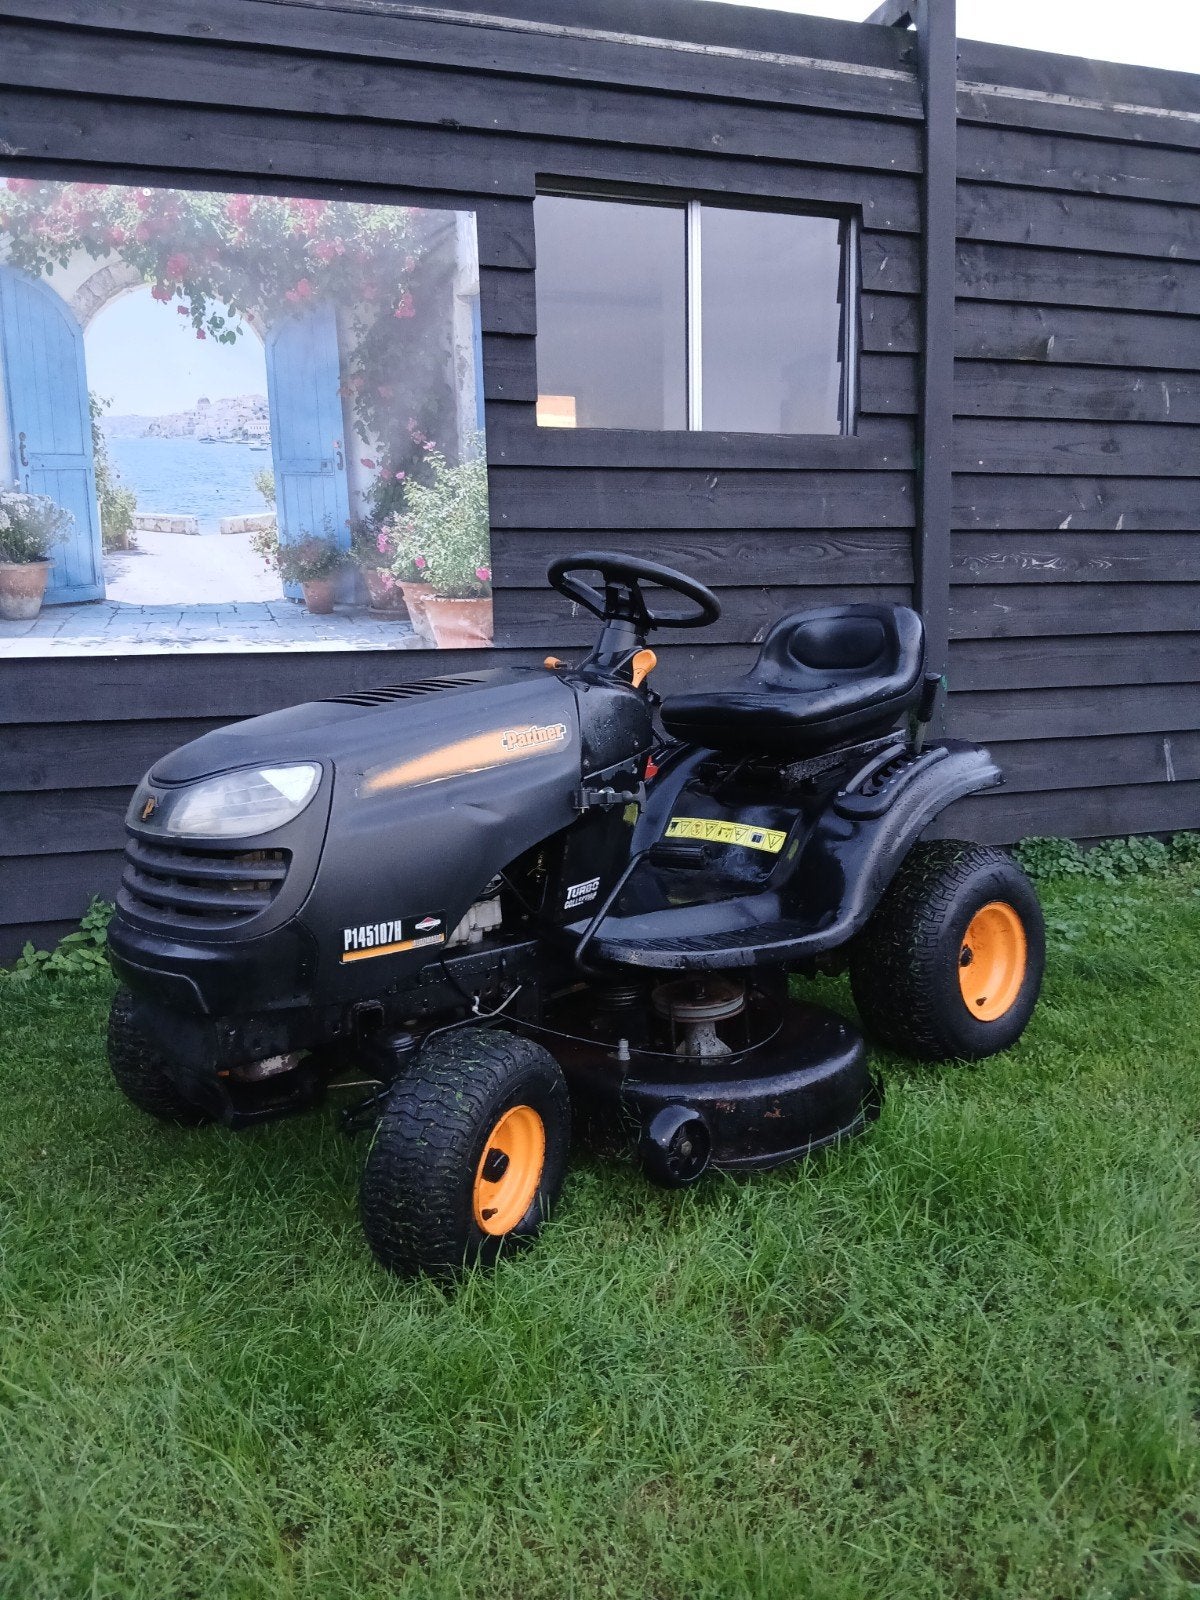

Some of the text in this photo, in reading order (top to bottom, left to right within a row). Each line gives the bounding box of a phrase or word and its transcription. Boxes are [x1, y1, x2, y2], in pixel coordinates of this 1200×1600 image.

[504, 724, 565, 750] Partner
[567, 877, 600, 900] TURBO
[344, 920, 402, 951] P145107H
